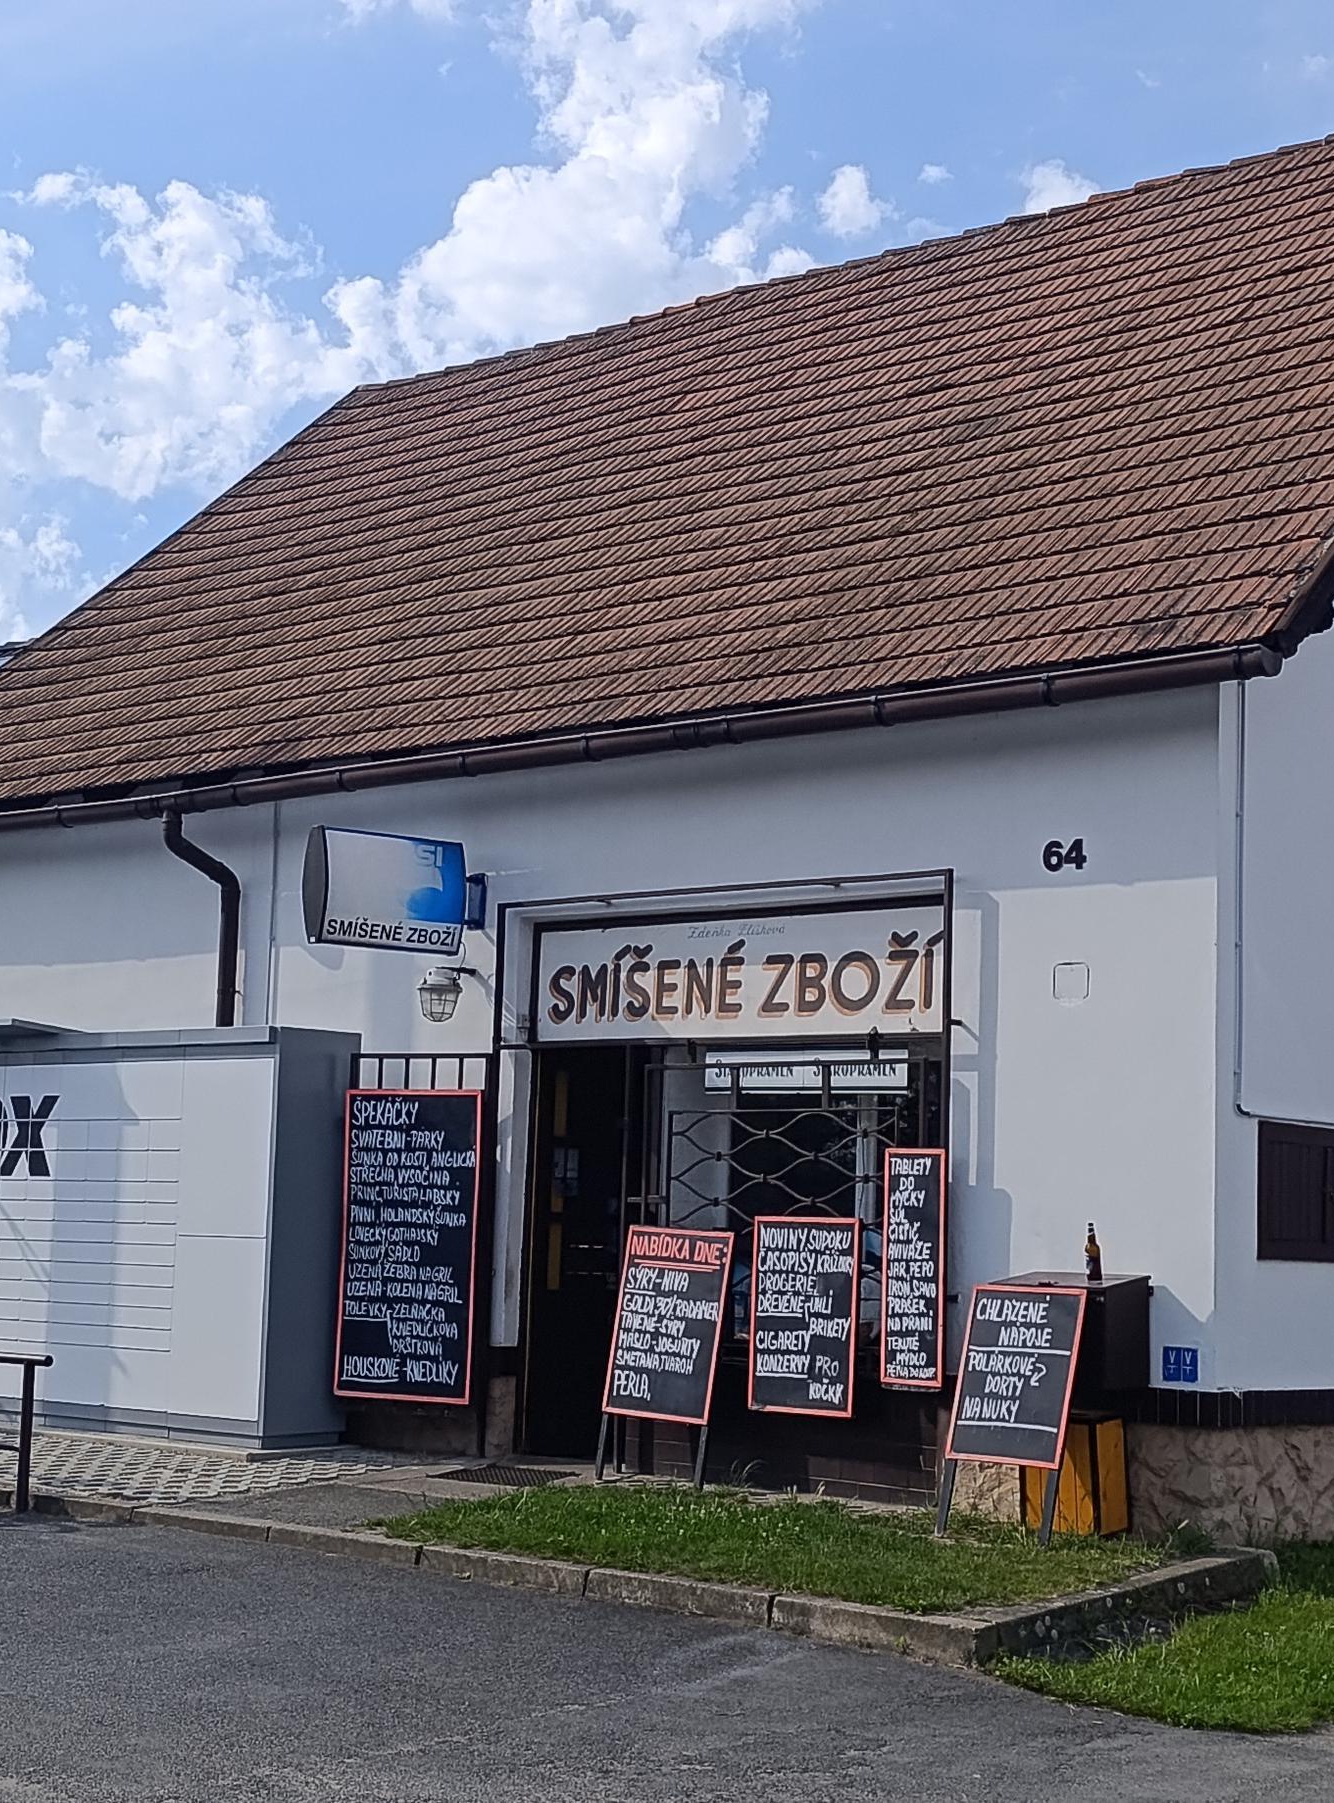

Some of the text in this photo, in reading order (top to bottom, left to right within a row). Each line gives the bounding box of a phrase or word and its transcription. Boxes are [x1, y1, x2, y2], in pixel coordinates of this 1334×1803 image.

[1042, 838, 1087, 872] 64
[326, 917, 458, 947] SMÍŠENÉ ZBOŽÍ
[547, 930, 945, 1025] SMÍŠENÉ ZBOŽÍ
[351, 1096, 419, 1125] ŠPEKÁČKY
[386, 1152, 399, 1166] OD
[889, 1157, 932, 1176] TABLETY
[899, 1176, 915, 1191] DO
[631, 1234, 690, 1260] NABÍDKA
[756, 1330, 810, 1352] CIGARETY
[810, 1317, 851, 1341] BRIKETY
[998, 1321, 1053, 1347] NÁPOJE
[756, 1353, 839, 1377] KONZERVY PRO
[984, 1373, 1025, 1397] DORTY
